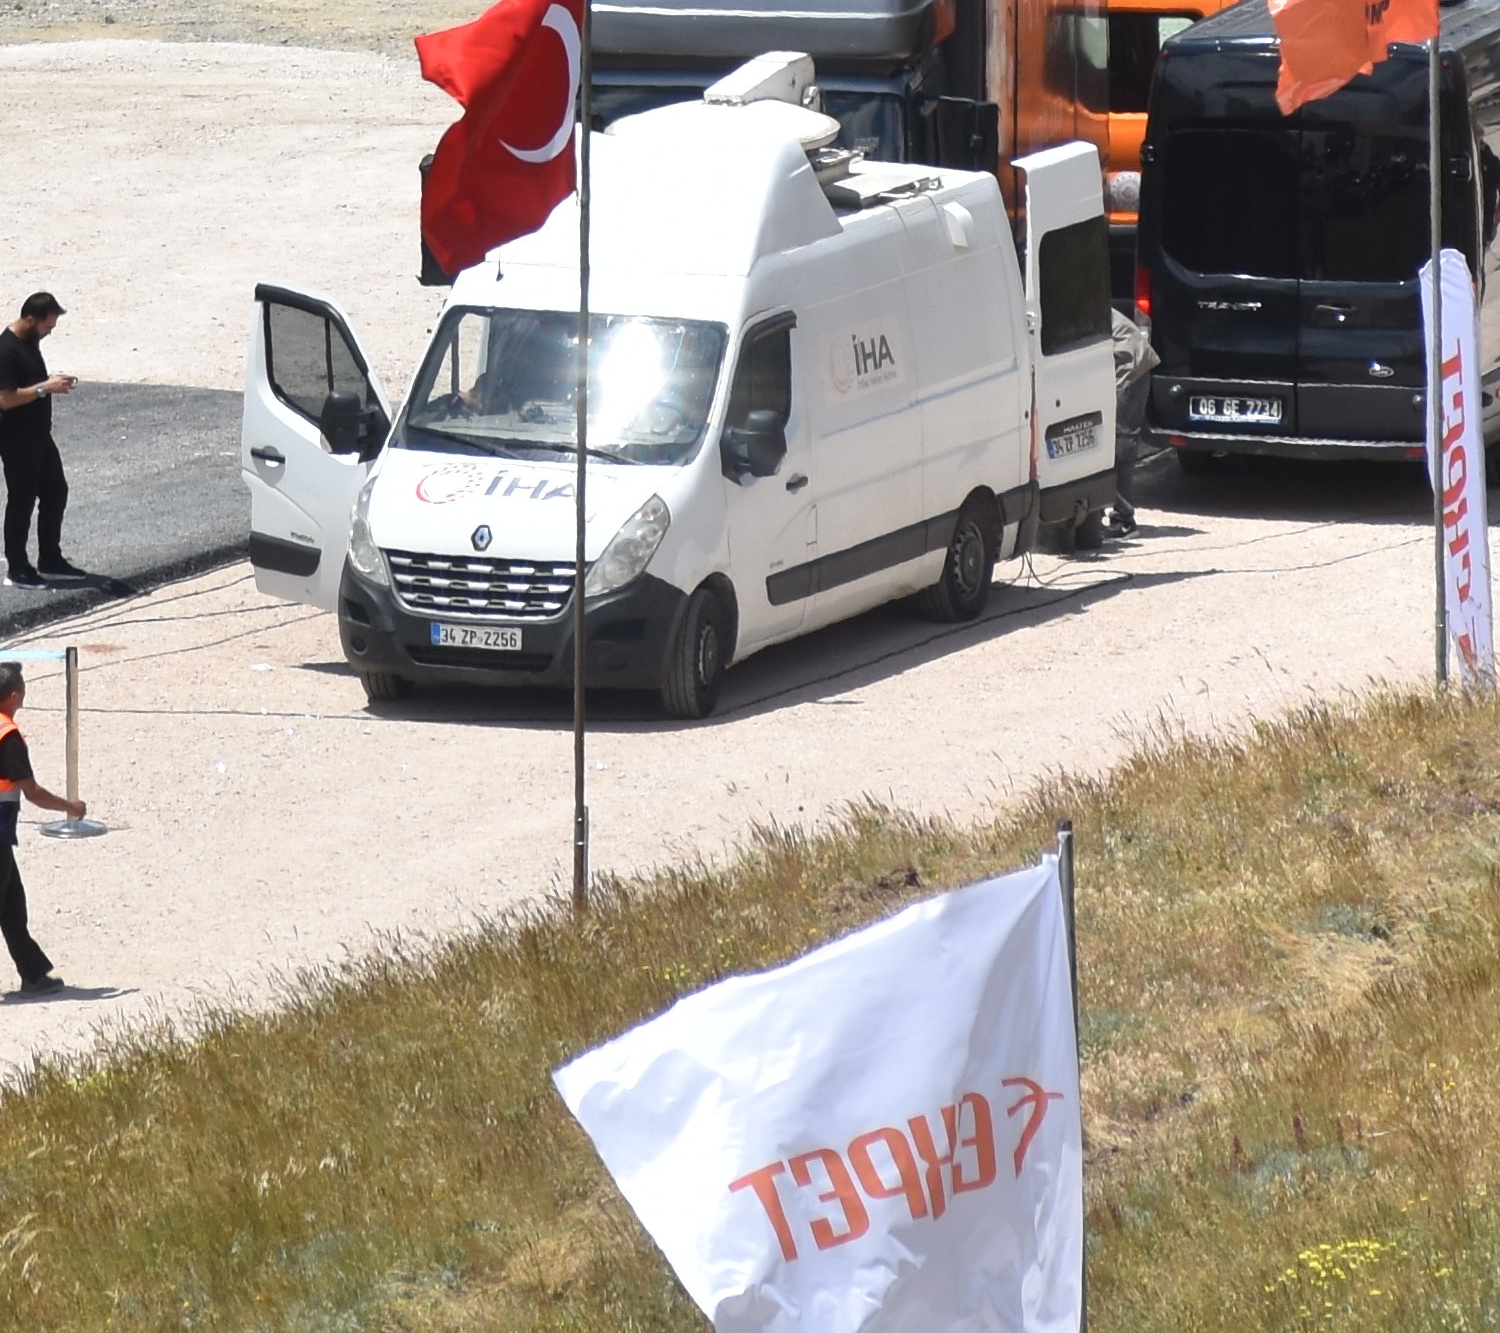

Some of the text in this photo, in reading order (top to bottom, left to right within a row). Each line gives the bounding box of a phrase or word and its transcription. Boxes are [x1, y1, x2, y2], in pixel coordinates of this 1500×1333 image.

[851, 333, 896, 376] İHA
[1199, 397, 1216, 415] 06
[441, 628, 518, 648] 34 ZP 2256
